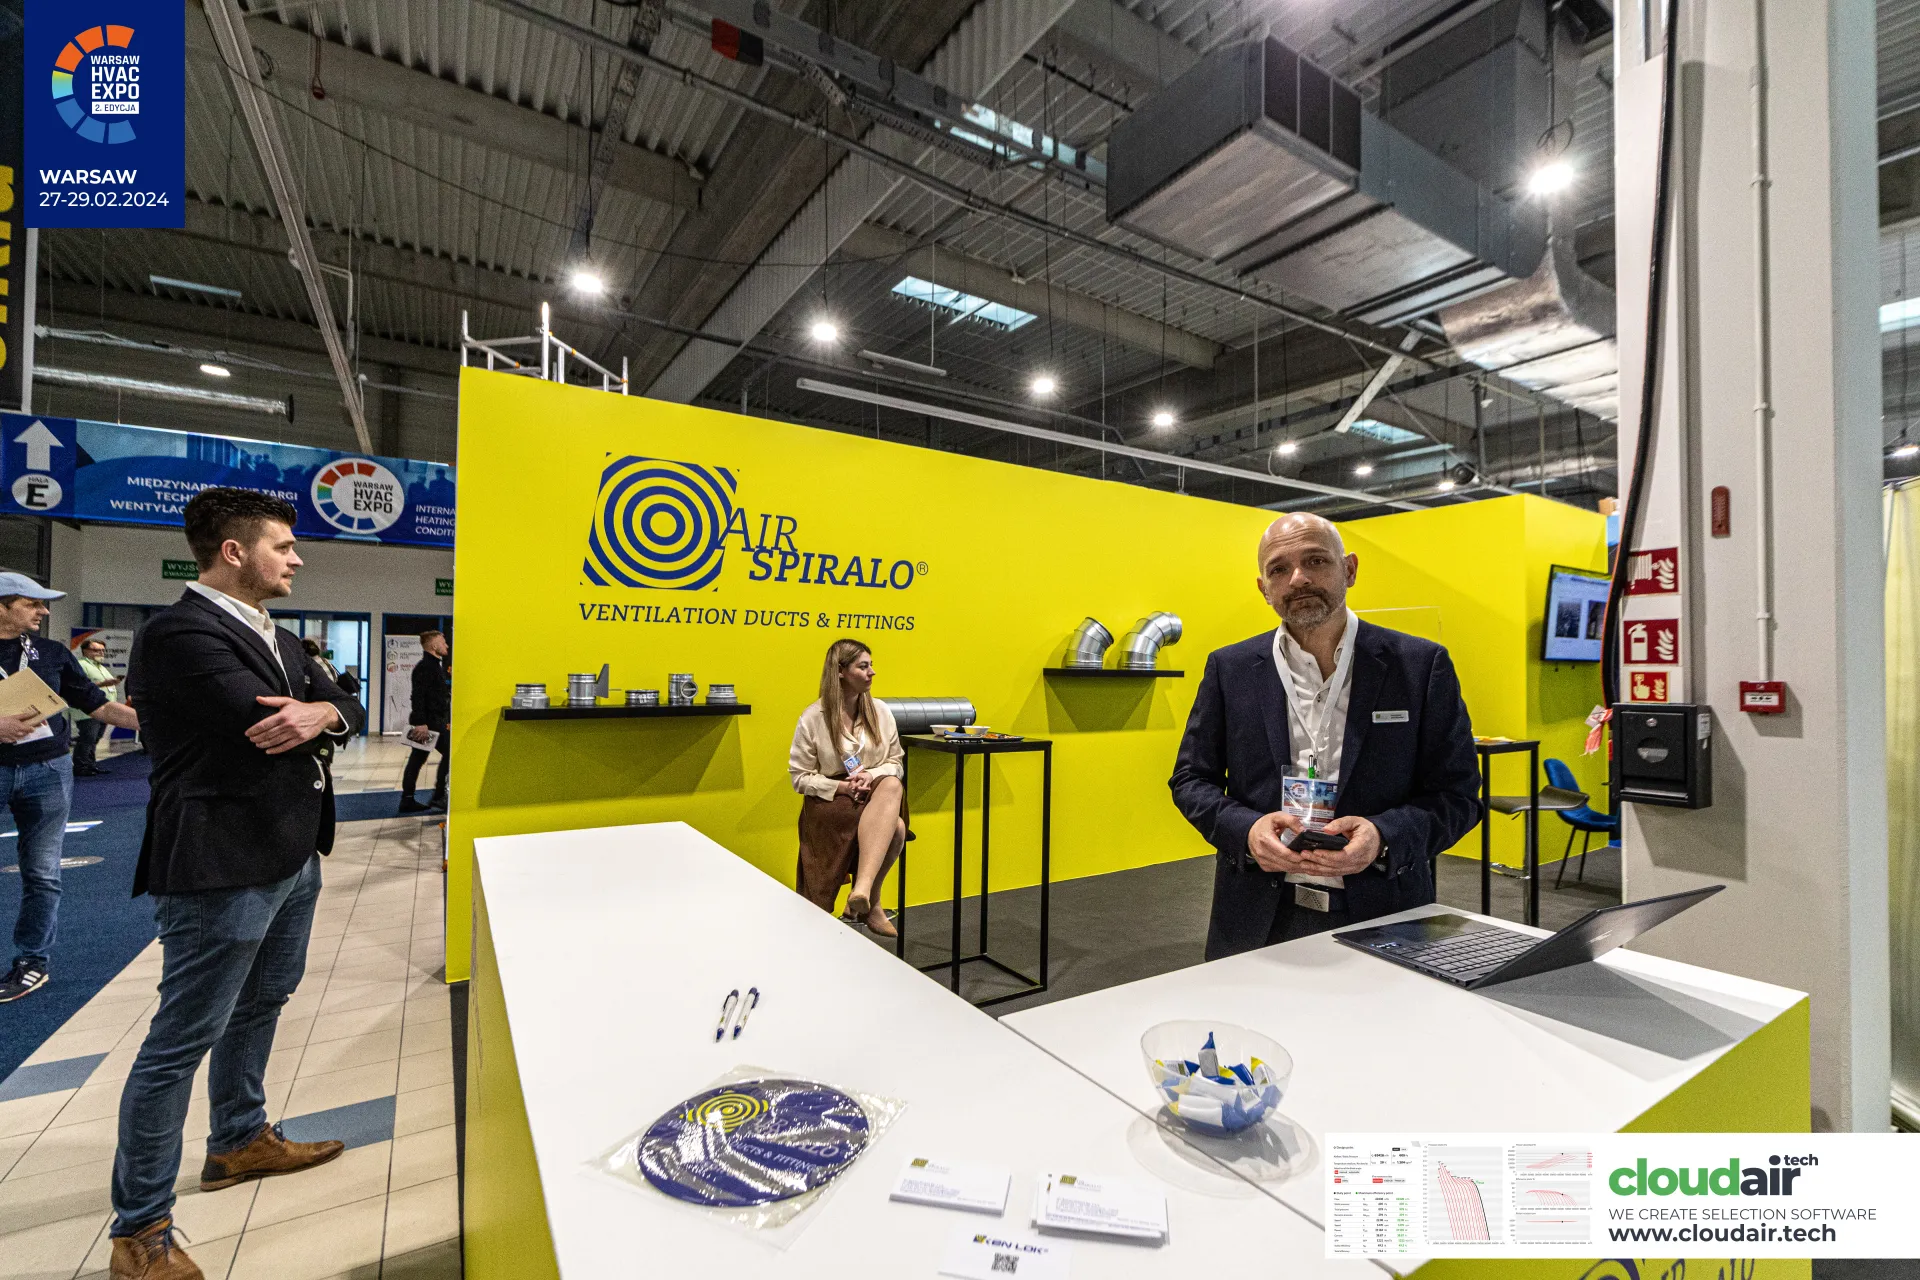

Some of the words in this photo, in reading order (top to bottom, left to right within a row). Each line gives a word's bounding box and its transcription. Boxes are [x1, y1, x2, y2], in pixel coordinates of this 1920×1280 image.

[26, 483, 49, 507] E
[353, 480, 394, 491] WARSAW
[353, 488, 393, 503] HVAC
[353, 499, 393, 514] EXPO
[716, 506, 799, 553] AIR
[579, 602, 737, 625] VENTILATION
[743, 609, 810, 629] DUCTS
[815, 612, 830, 628] &
[835, 612, 916, 632] FITTINGS
